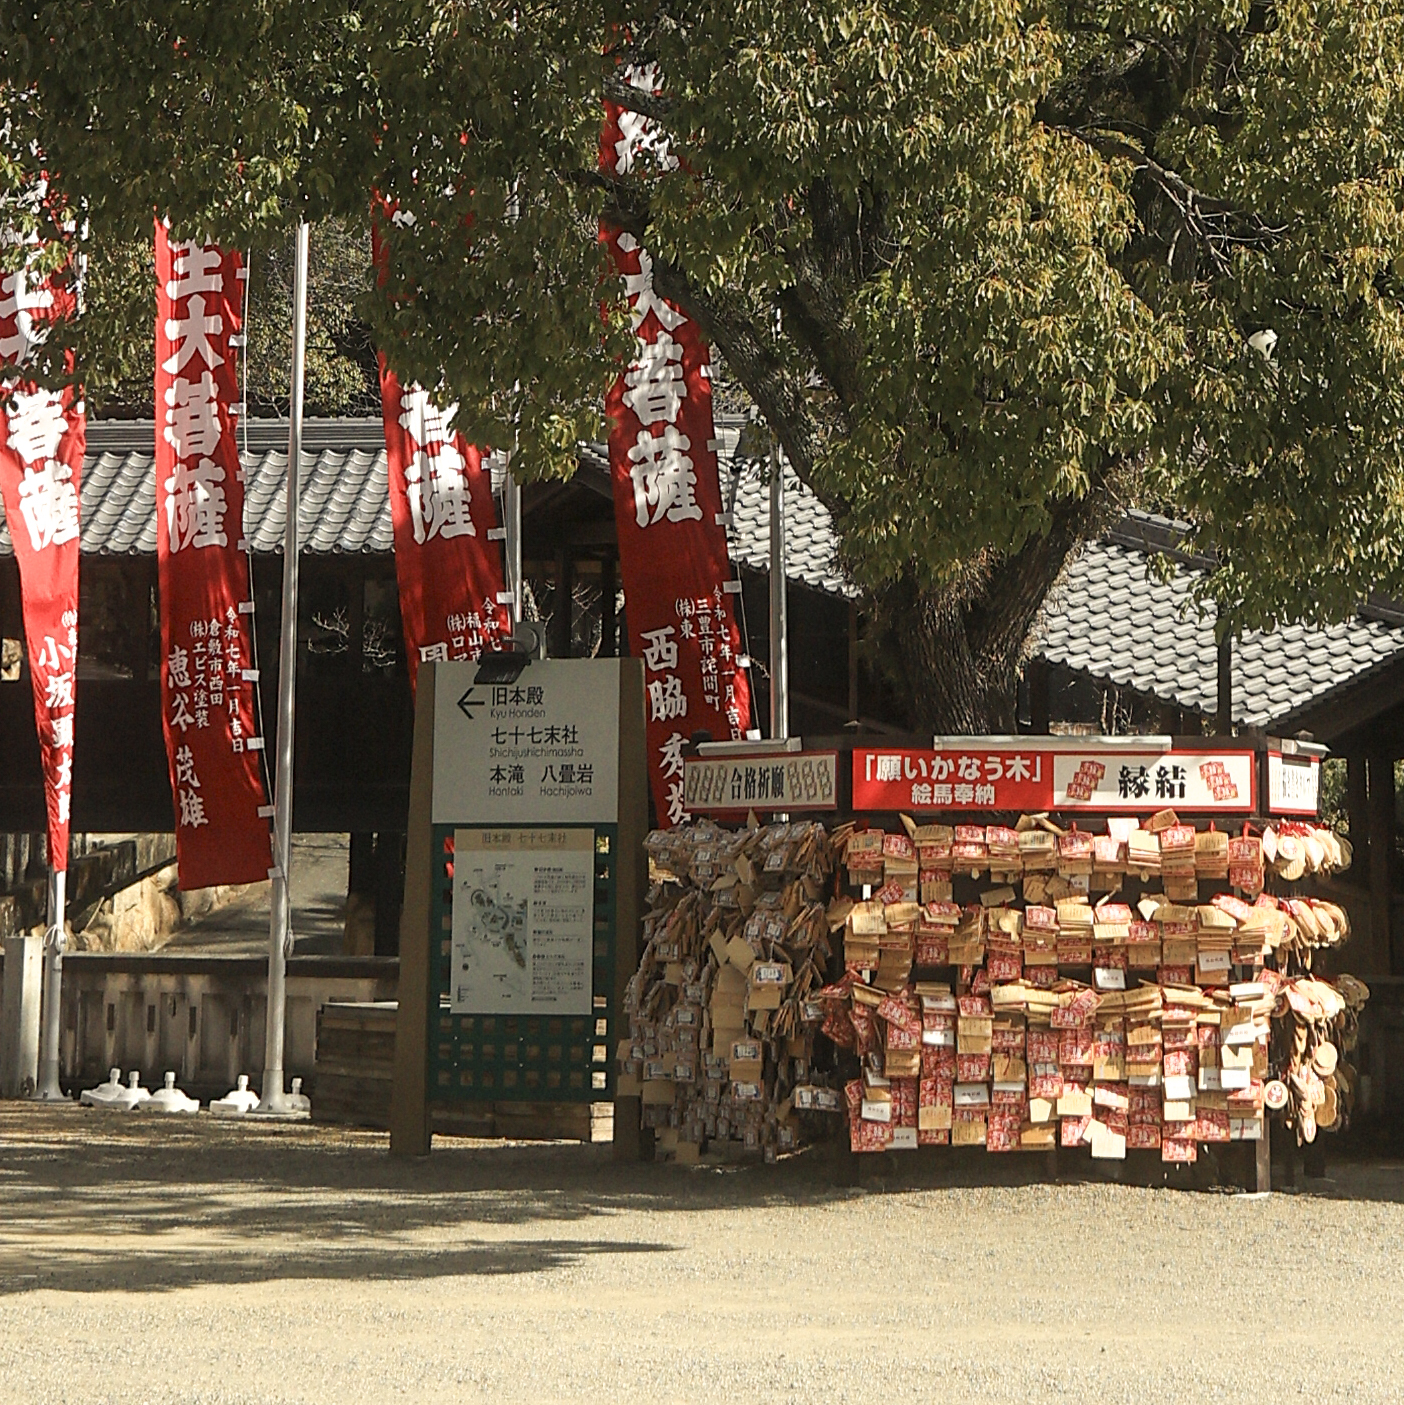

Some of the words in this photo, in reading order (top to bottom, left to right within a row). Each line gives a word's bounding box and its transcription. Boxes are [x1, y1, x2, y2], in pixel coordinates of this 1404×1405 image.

[713, 584, 743, 741] 令和七年一月吉日
[224, 605, 244, 754] 令和七年一月吉日
[490, 686, 545, 706] 旧本殿
[490, 708, 507, 720] Kyu
[508, 708, 546, 718] Honden
[490, 725, 579, 745] 七十七末社
[489, 746, 584, 758] Shichijushichimassha
[489, 764, 525, 784] 本滝
[540, 764, 594, 784] 八畳岩
[865, 752, 1042, 782] 「願いかなう木」
[730, 766, 785, 800] 合格祈願
[1118, 764, 1188, 799] 縁結
[911, 783, 996, 805] 絵馬奉納
